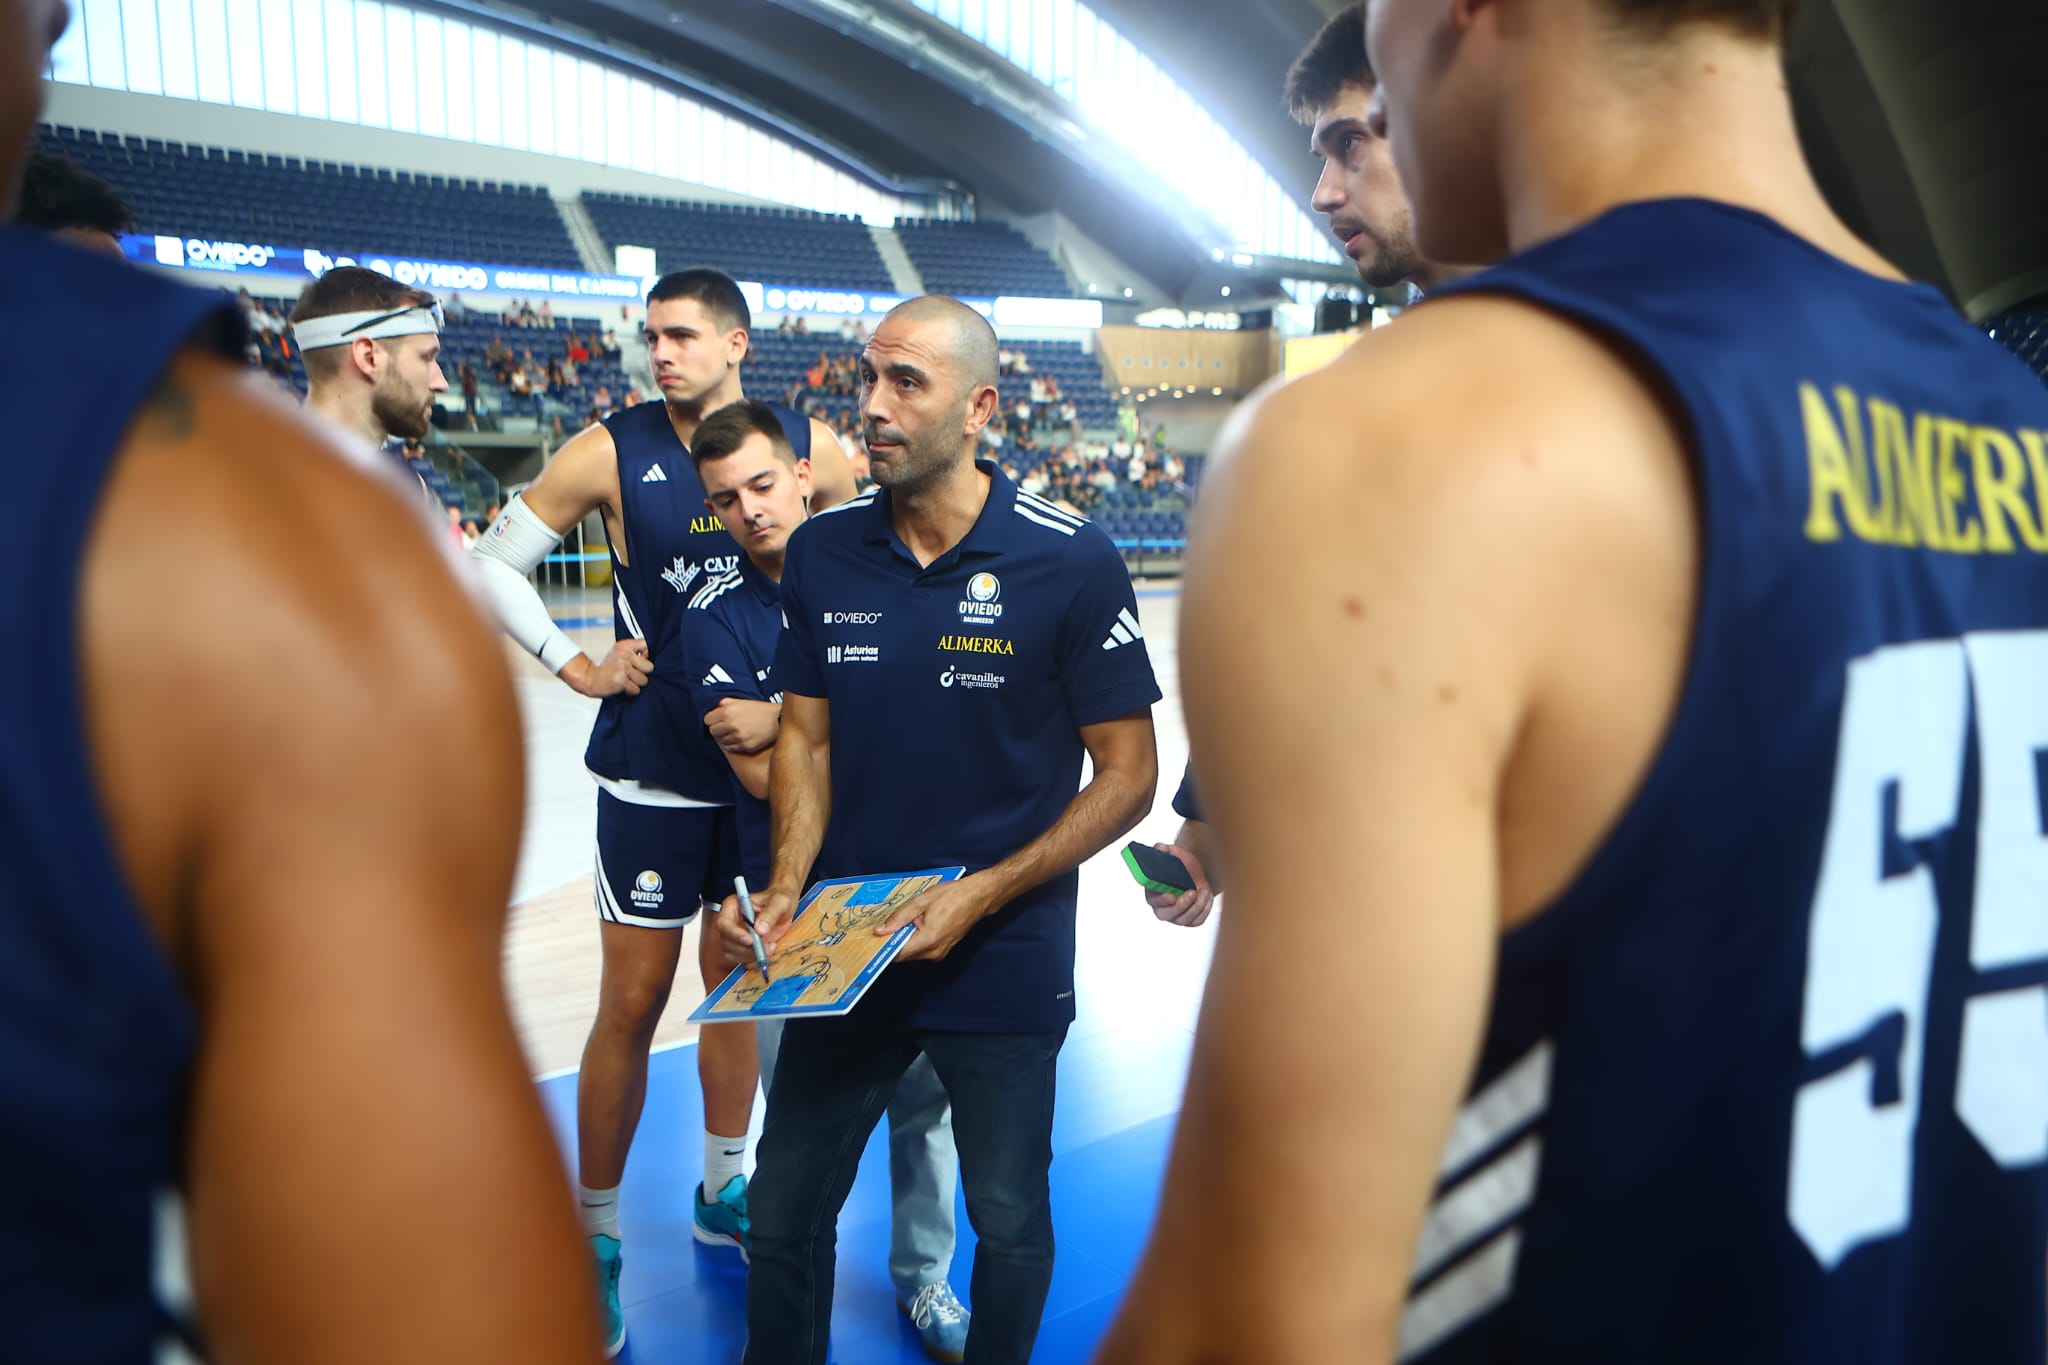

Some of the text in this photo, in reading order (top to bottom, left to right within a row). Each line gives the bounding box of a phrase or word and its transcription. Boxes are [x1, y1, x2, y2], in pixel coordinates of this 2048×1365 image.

[186, 239, 268, 268] OVIEDO
[394, 260, 488, 291] OVIEDO
[689, 515, 726, 534] ALIM
[959, 601, 1003, 617] OVIEDO
[834, 612, 877, 624] OVIEDO
[844, 644, 879, 655] Asturias
[937, 635, 1014, 655] ALIMERKA
[955, 672, 1005, 683] cavanilles
[961, 679, 999, 689] ingenieros
[630, 890, 664, 902] OVIEDO
